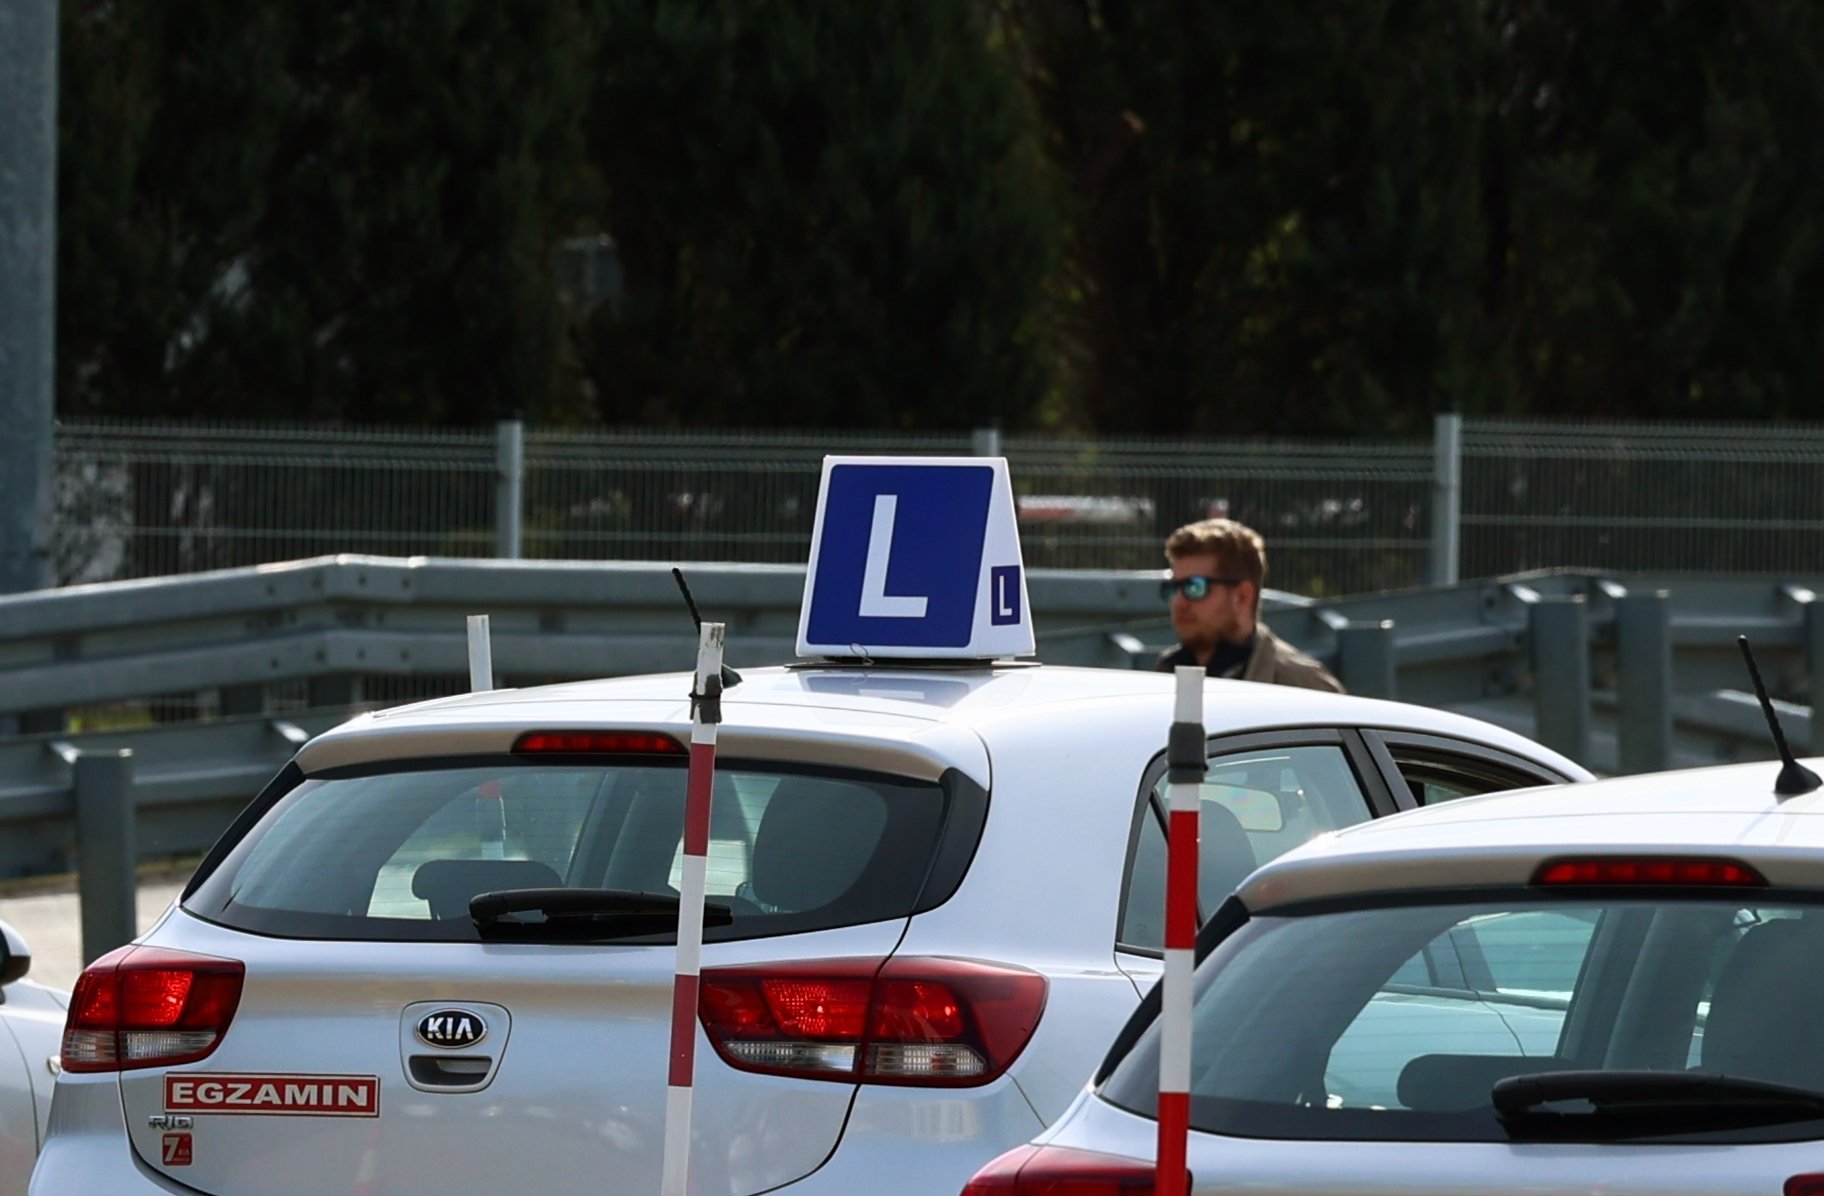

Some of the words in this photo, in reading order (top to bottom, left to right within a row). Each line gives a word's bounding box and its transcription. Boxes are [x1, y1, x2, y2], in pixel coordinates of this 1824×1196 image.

[858, 494, 928, 618] L
[999, 575, 1013, 616] L
[427, 1017, 474, 1040] KIA
[172, 1082, 369, 1107] EGZAMIN
[164, 1137, 180, 1161] 7
